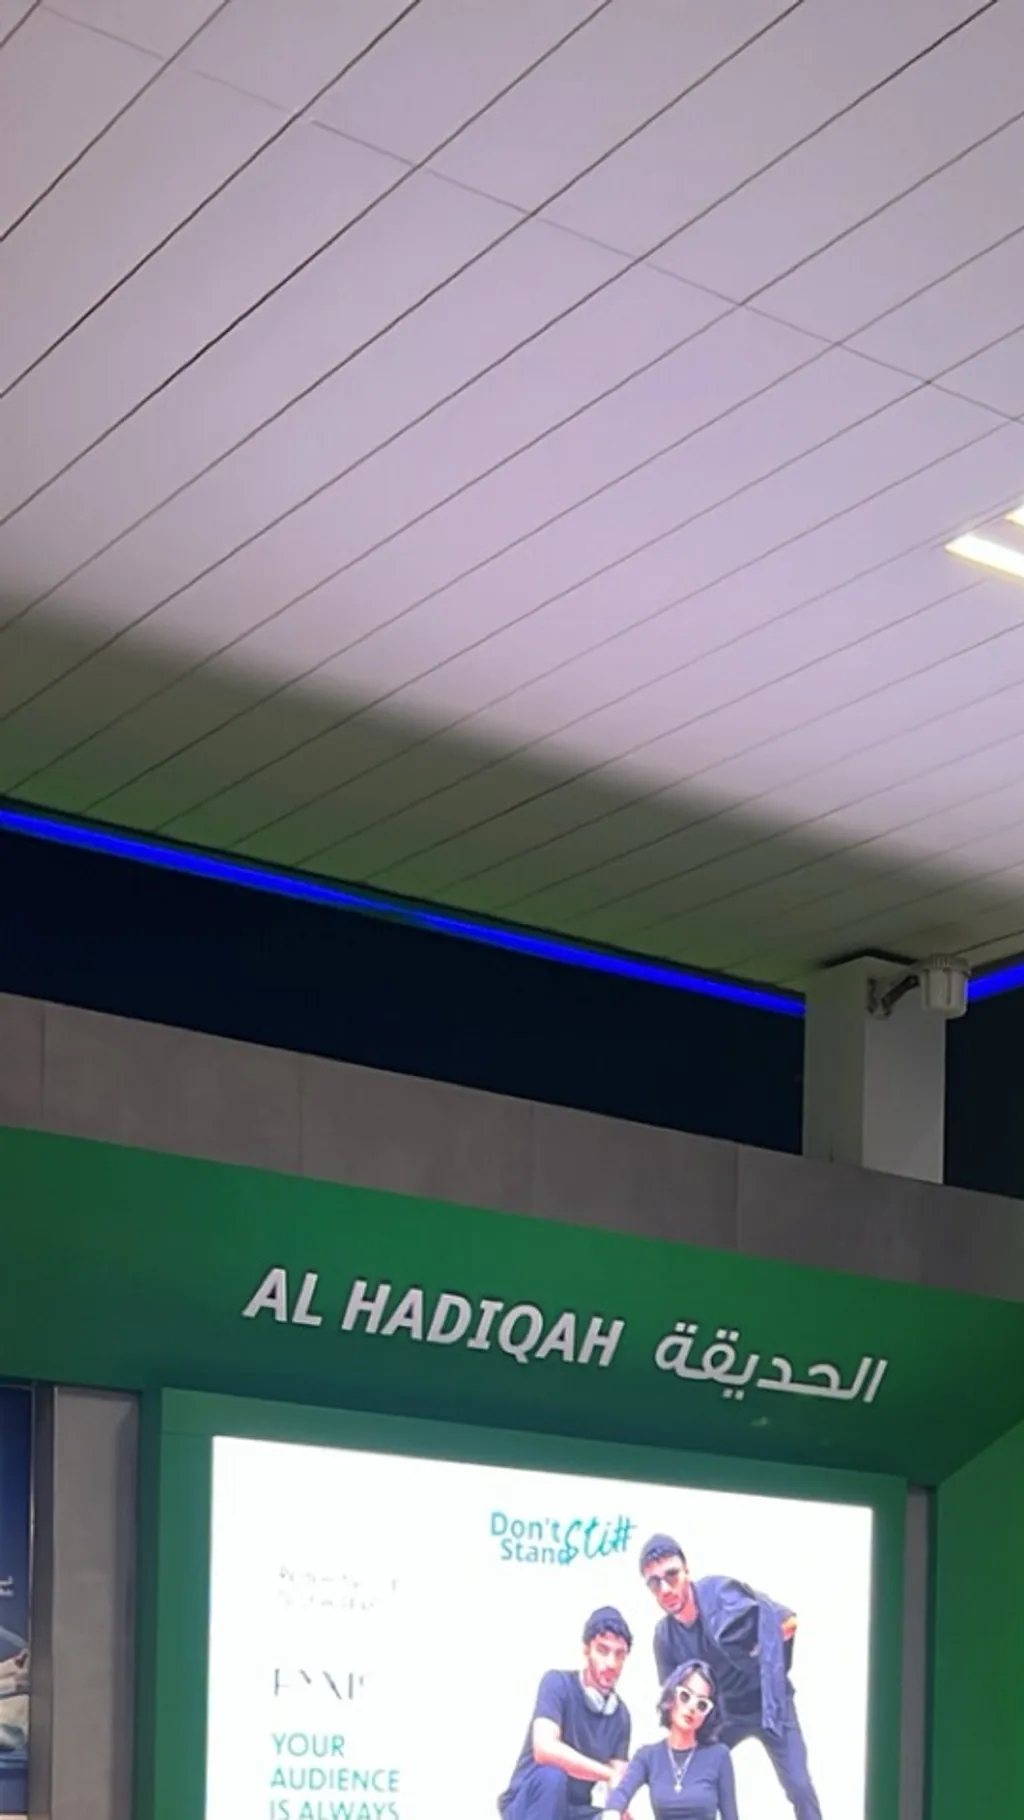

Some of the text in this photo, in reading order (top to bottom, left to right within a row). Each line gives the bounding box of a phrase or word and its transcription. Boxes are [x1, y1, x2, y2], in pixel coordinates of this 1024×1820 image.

[244, 1267, 624, 1366] AL HADIQAH
[655, 1322, 888, 1403] الحديقة
[490, 1511, 561, 1543] Don't
[272, 1732, 345, 1759] YOUR
[270, 1767, 400, 1793] AUDIENCE
